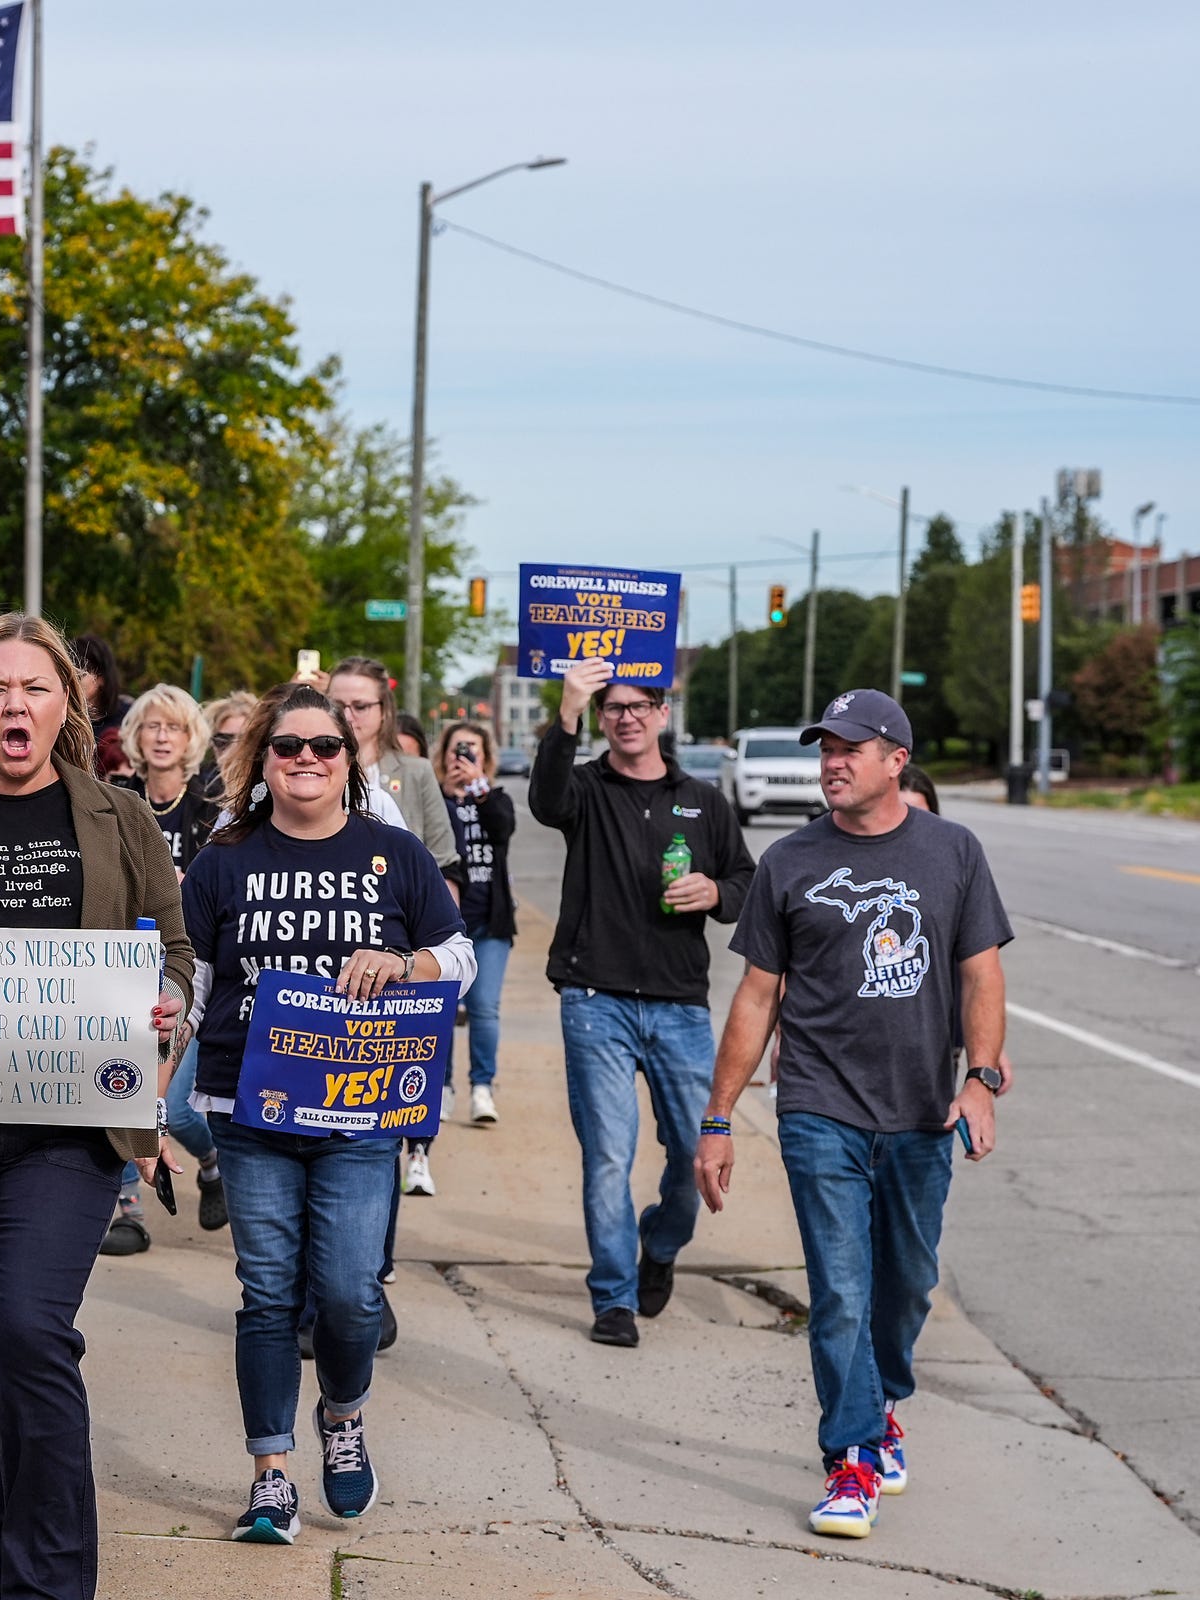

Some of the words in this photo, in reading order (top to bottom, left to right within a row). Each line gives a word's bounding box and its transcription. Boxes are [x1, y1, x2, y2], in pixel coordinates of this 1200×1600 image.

[530, 576, 605, 591] COREWELL
[608, 580, 667, 596] NURSES
[576, 592, 622, 607] VOTE
[530, 604, 665, 631] TEAMSTERS
[567, 629, 625, 658] YES!
[617, 662, 662, 678] UNITED
[29, 840, 61, 849] time
[12, 863, 70, 874] change.
[5, 879, 43, 891] lived
[246, 872, 379, 904] NURSES
[32, 896, 72, 907] after.
[237, 910, 384, 945] INSPIRE
[25, 940, 96, 968] NURSES
[104, 942, 157, 968] UNION
[864, 958, 923, 982] BETTER
[36, 978, 75, 1004] YOU!
[875, 973, 916, 995] MADE
[277, 989, 380, 1016] COREWELL
[383, 997, 443, 1016] NURSES
[18, 1015, 66, 1041] CARD
[74, 1016, 131, 1042] TODAY
[345, 1020, 396, 1037] VOTE
[270, 1027, 438, 1064] TEAMSTERS
[8, 1050, 19, 1073] A
[26, 1050, 85, 1073] VOICE!
[11, 1081, 22, 1103] A
[30, 1081, 82, 1105] VOTE!
[323, 1065, 394, 1108] YES!
[300, 1112, 321, 1122] ALL
[322, 1114, 371, 1125] CAMPUSES
[380, 1104, 428, 1129] UNITED
